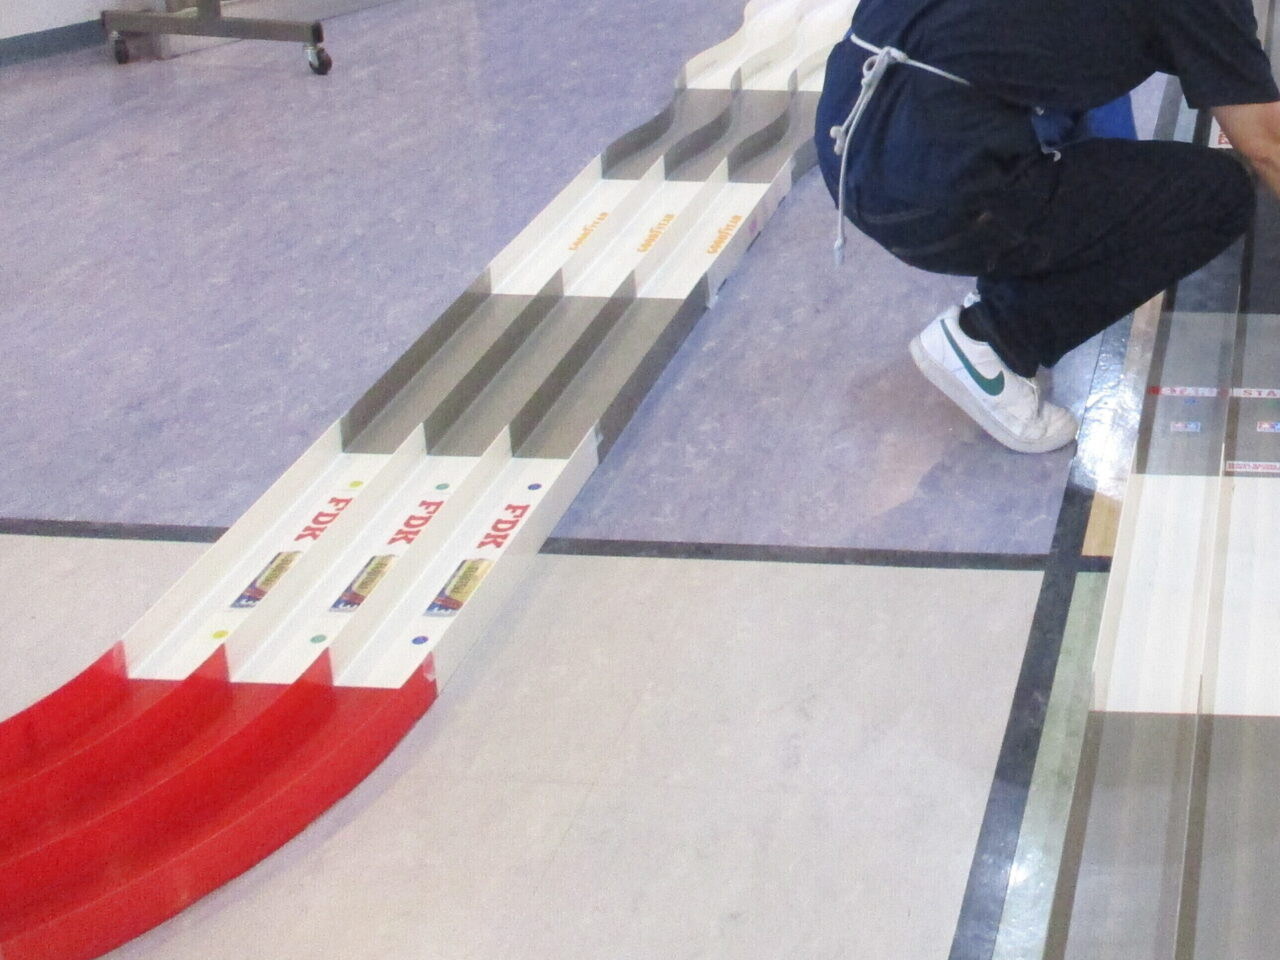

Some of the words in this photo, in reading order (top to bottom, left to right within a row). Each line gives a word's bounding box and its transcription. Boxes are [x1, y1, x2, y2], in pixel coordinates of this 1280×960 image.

[294, 497, 353, 541] FDK
[387, 500, 444, 545] FDK
[476, 504, 530, 550] FDK
